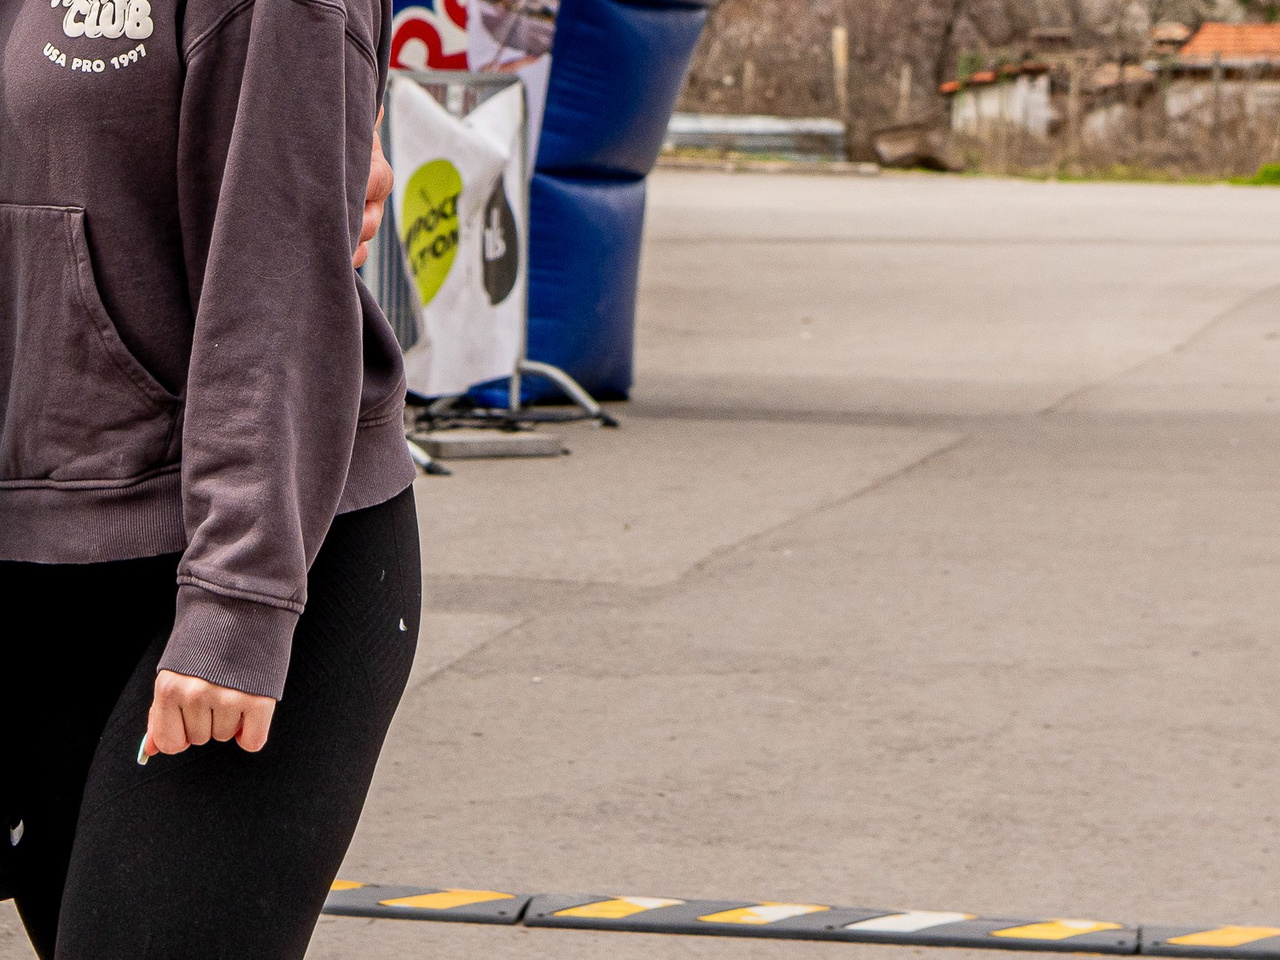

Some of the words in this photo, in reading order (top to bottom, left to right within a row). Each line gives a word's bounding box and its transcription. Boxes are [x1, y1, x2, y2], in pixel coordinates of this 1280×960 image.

[43, 42, 67, 67] USA
[71, 57, 106, 73] PRO
[110, 43, 147, 70] 1997
